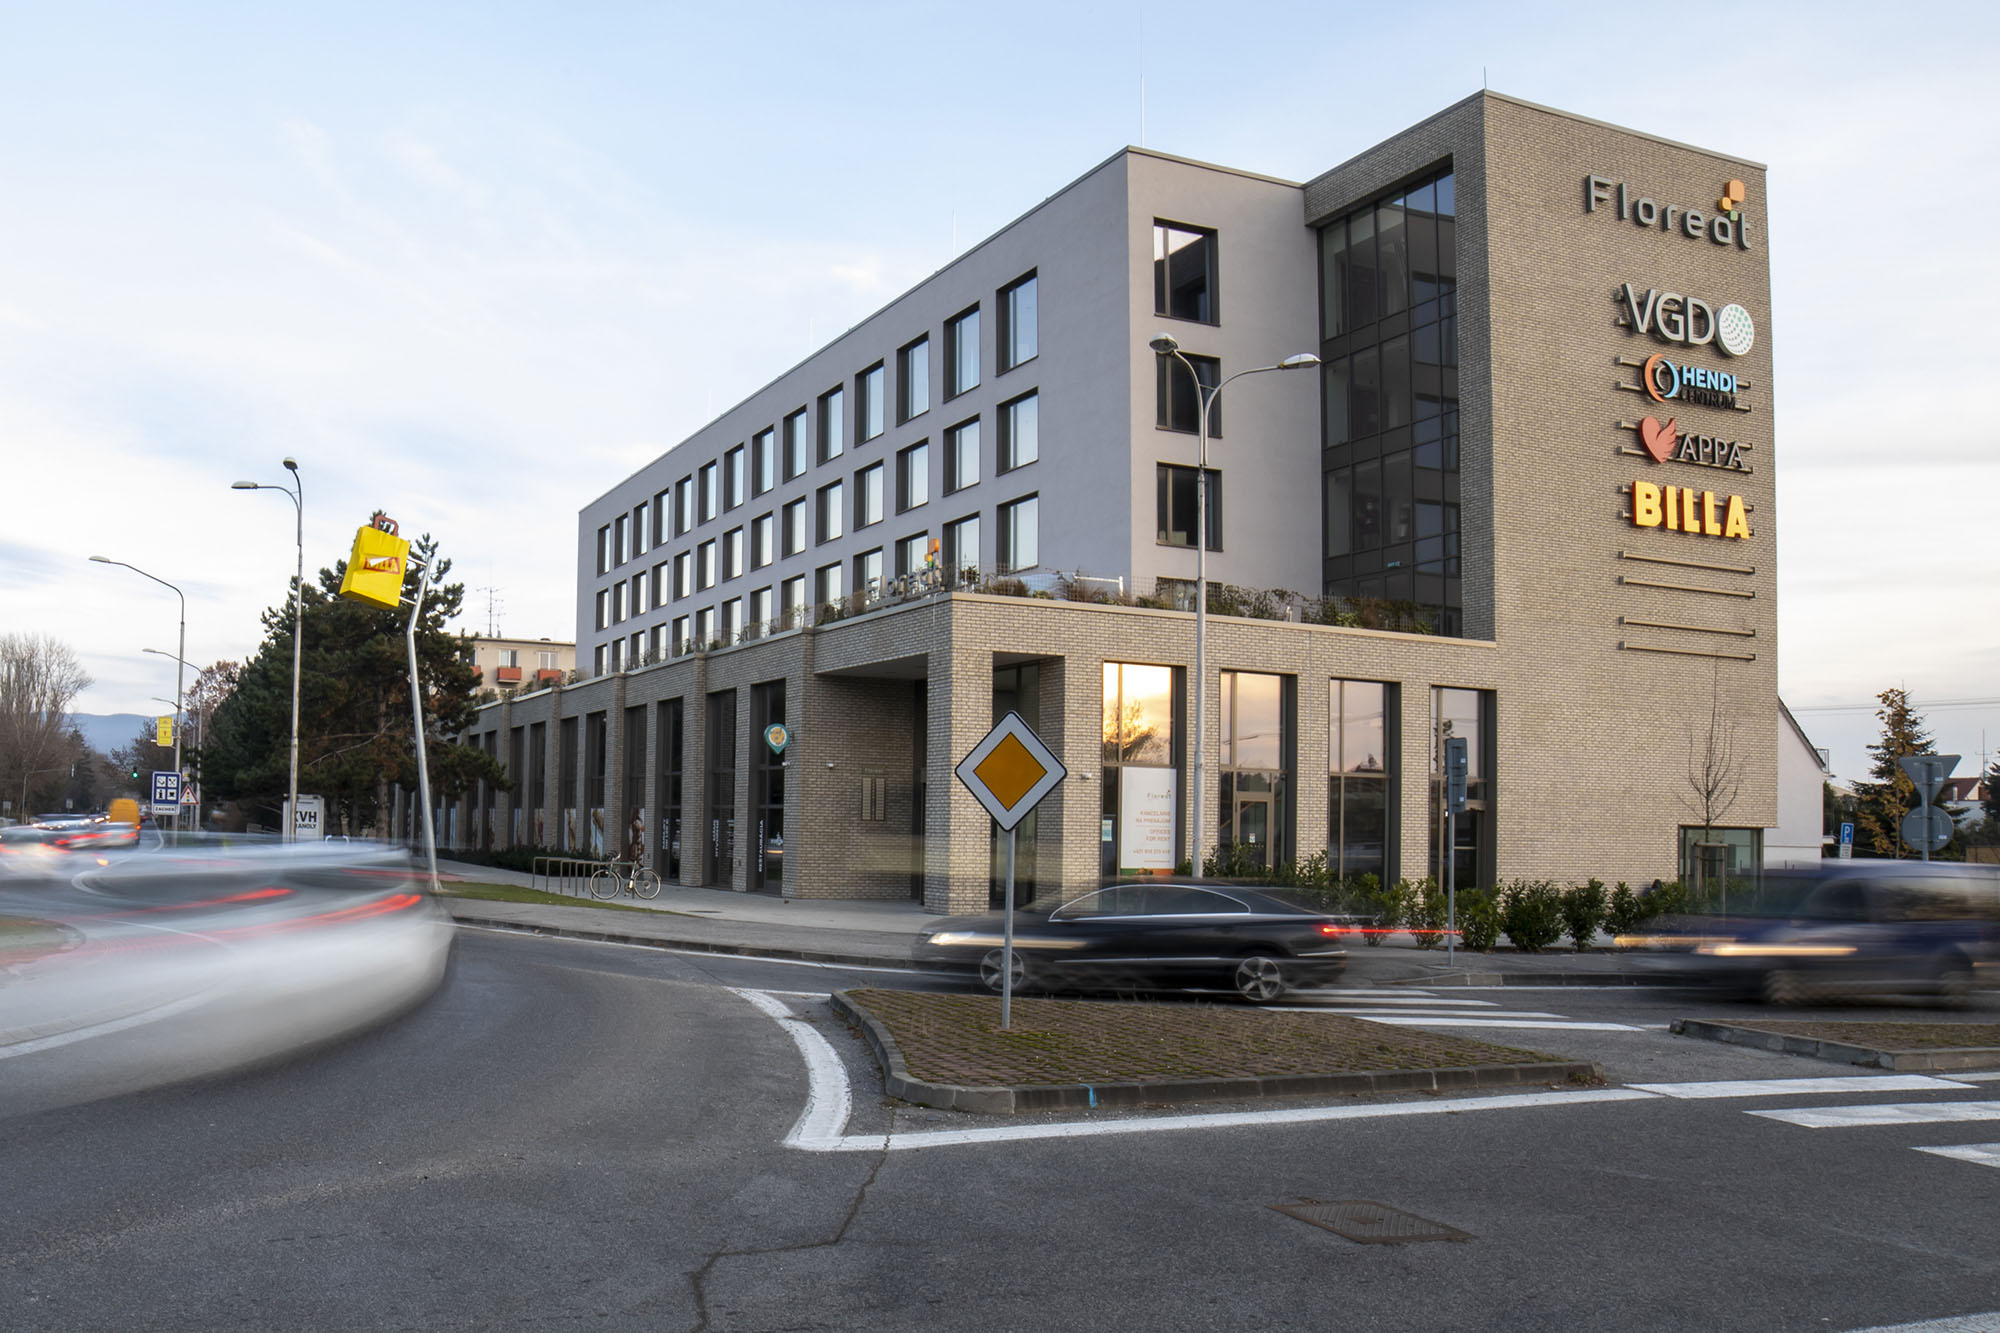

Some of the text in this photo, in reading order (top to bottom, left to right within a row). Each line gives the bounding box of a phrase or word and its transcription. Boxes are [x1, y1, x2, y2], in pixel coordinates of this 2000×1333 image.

[1586, 174, 1751, 250] Floreat
[1682, 365, 1738, 394] HENDI
[1680, 388, 1736, 409] CENTRUM
[1678, 433, 1745, 468] APPA
[1632, 480, 1750, 539] BILLA
